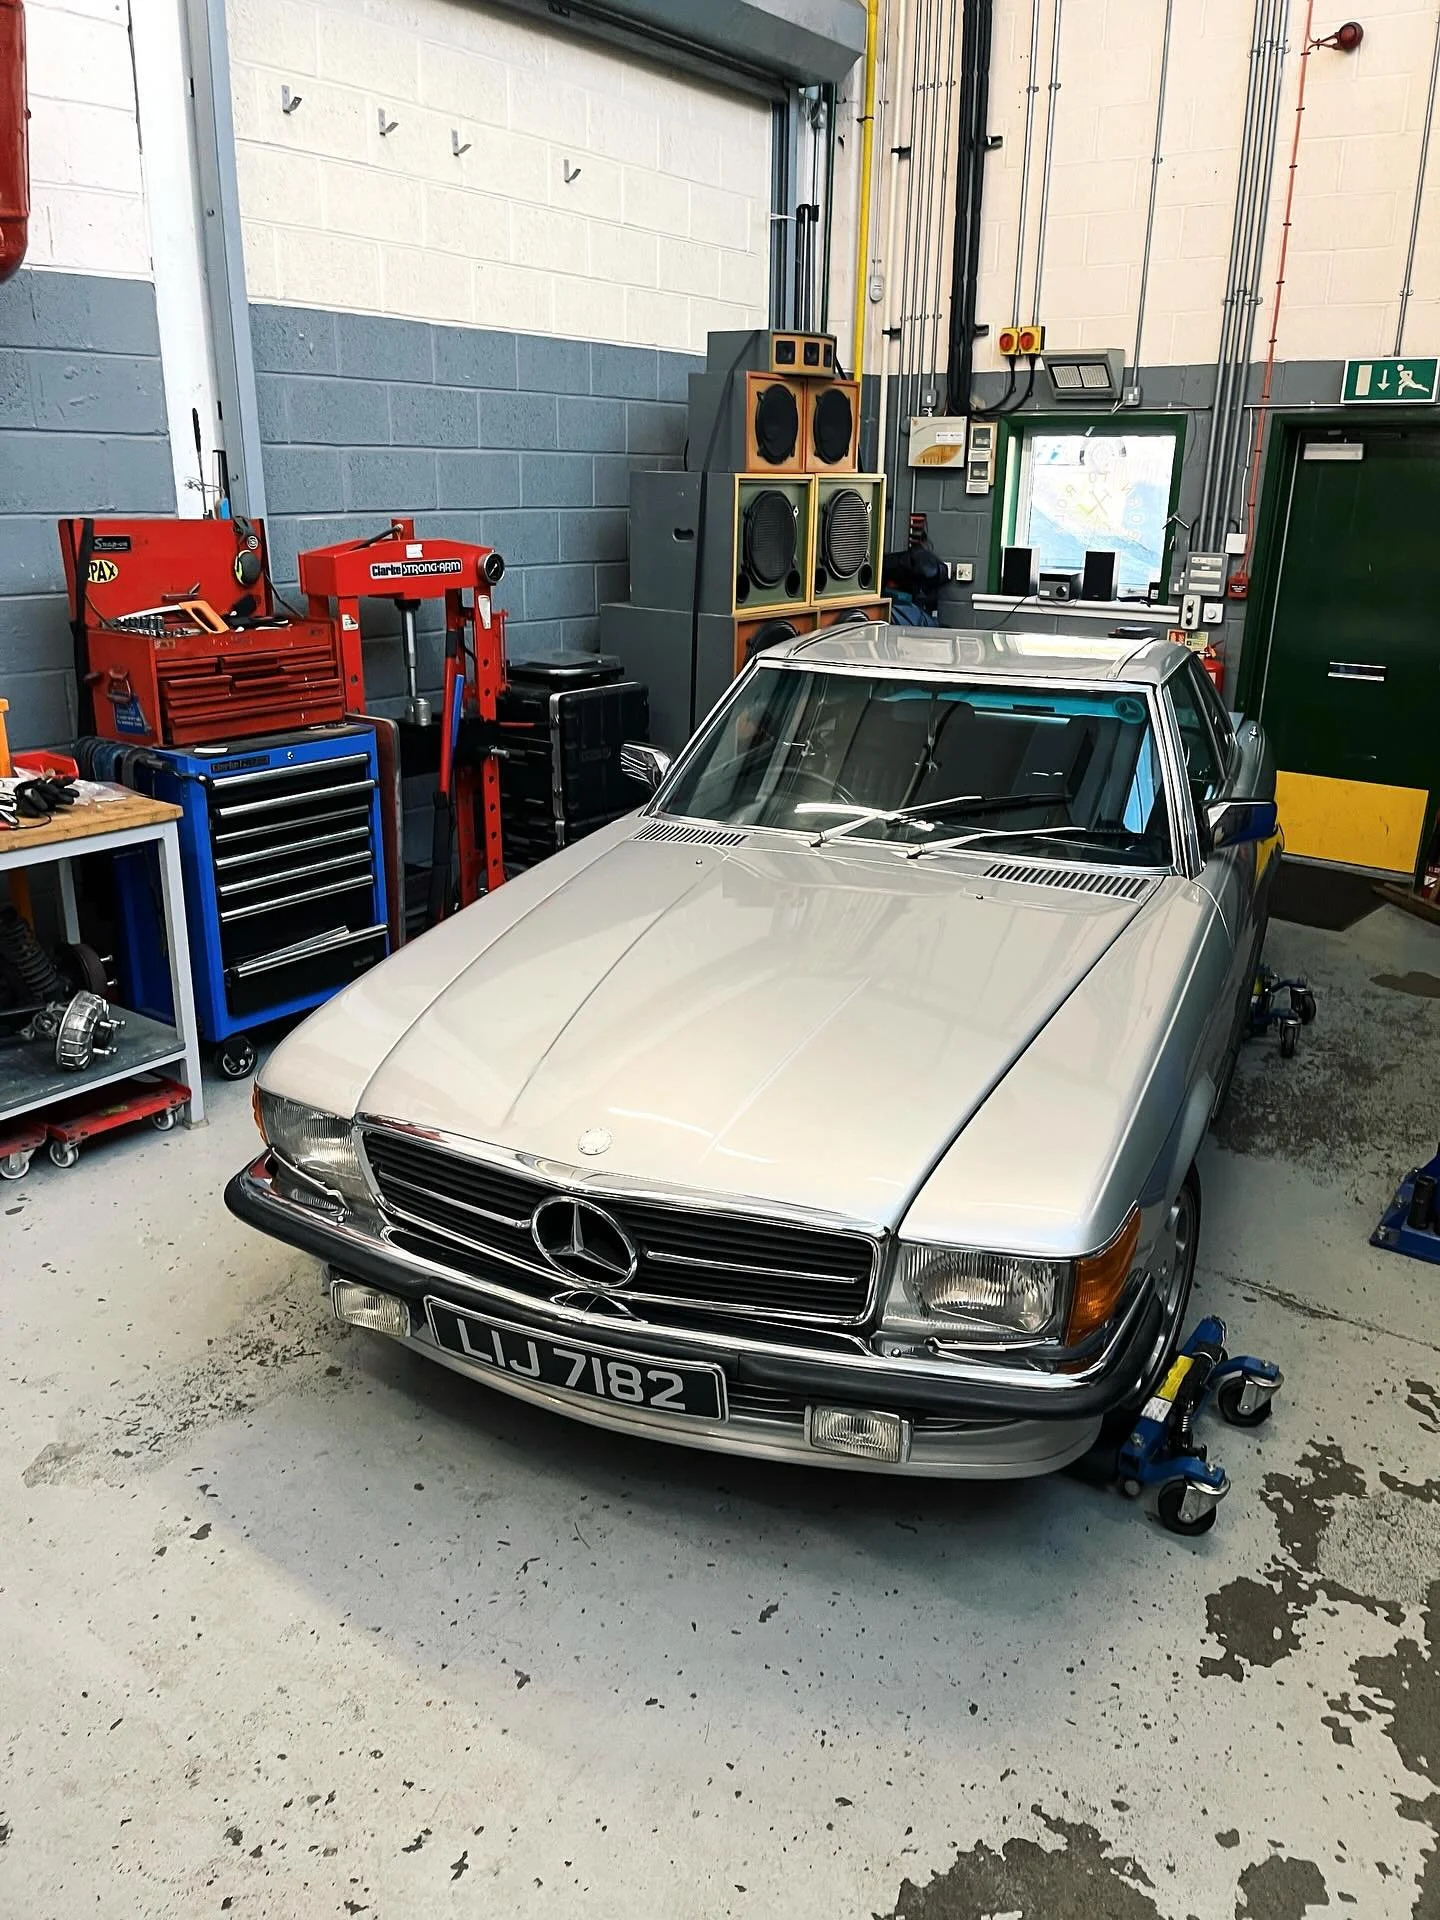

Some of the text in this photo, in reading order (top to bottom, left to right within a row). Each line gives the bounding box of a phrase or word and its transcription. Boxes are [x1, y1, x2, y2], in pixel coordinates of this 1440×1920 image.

[88, 560, 116, 581] PAX
[371, 561, 460, 577] Clarke STRONG-ARM
[457, 1318, 686, 1411] LIJ 7182
